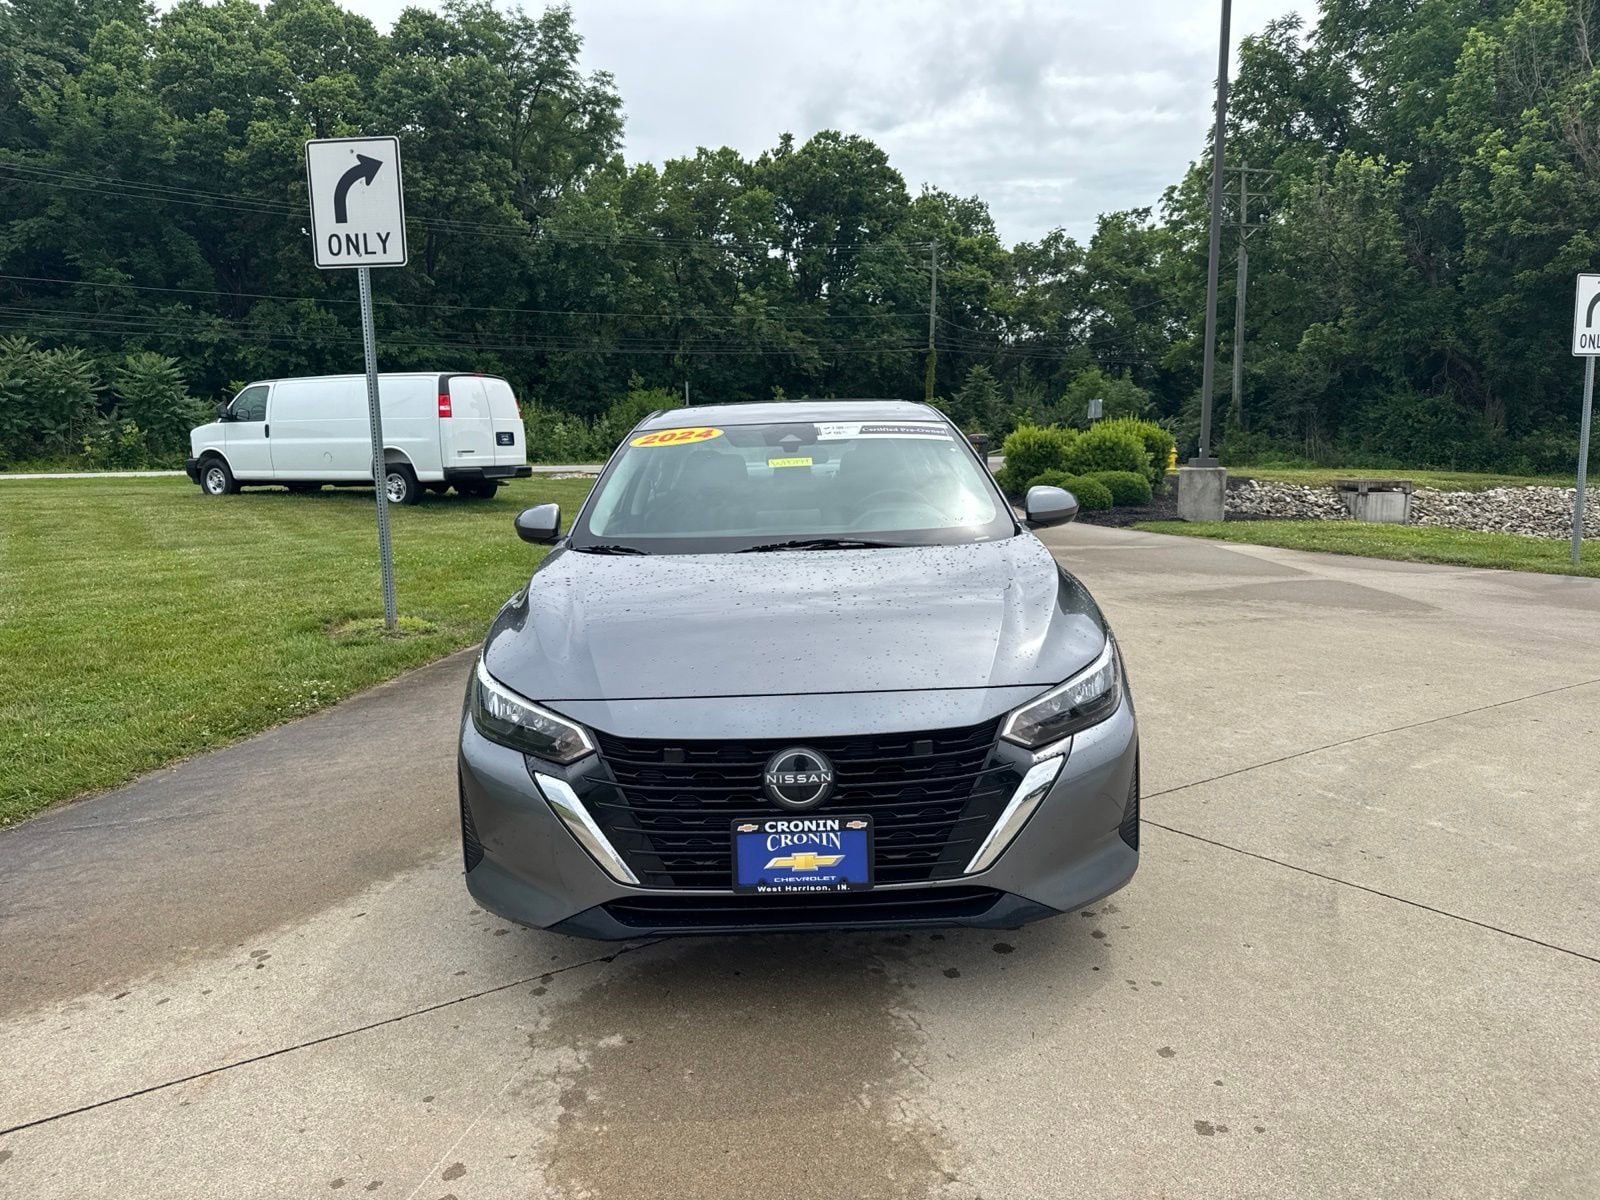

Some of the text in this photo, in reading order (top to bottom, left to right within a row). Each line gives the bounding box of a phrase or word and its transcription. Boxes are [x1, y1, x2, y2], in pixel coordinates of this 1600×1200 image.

[328, 232, 391, 256] ONLY
[639, 429, 714, 445] 2024
[766, 773, 831, 784] NISSAN
[764, 820, 840, 832] CRONIN
[766, 832, 842, 852] CRONIN
[785, 884, 831, 892] Harrison,
